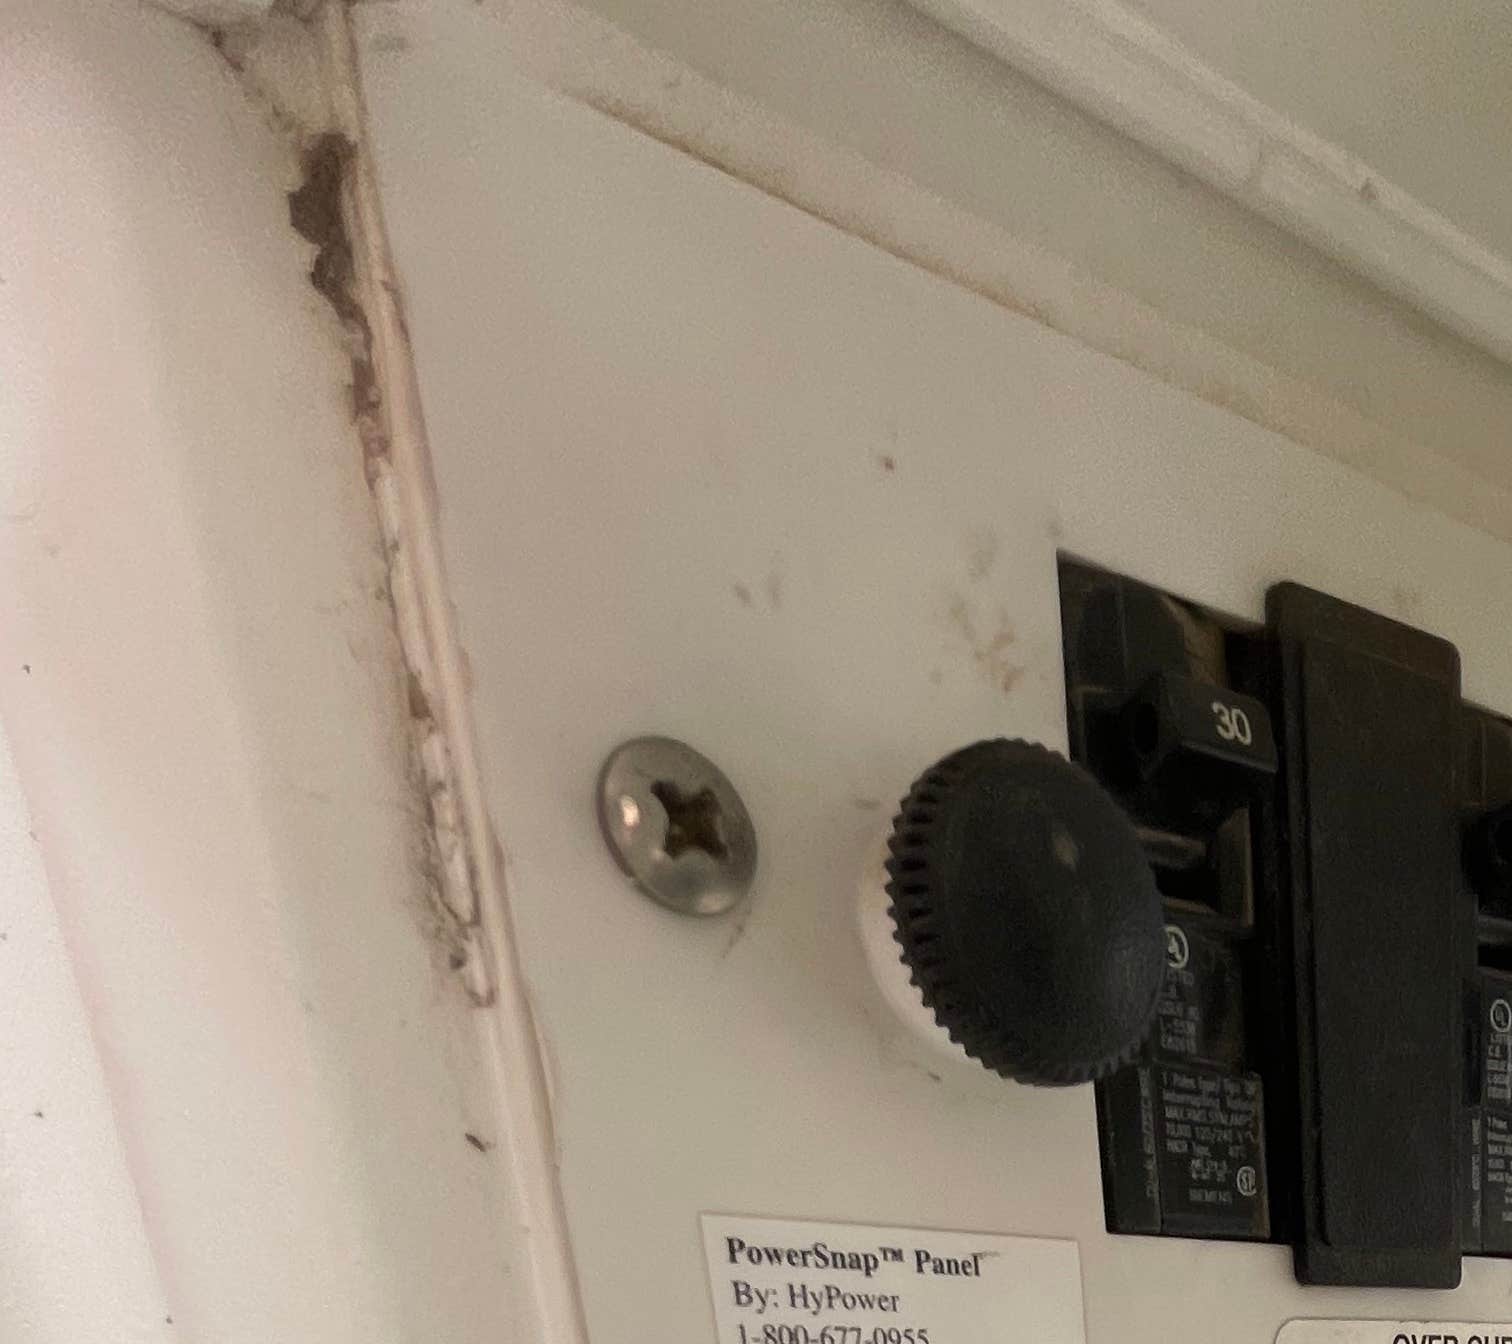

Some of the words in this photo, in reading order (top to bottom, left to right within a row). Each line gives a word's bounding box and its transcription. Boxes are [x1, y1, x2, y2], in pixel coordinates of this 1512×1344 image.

[1212, 702, 1251, 746] 30
[914, 1249, 982, 1277] Panel
[731, 1280, 780, 1314] By:
[788, 1284, 900, 1315] HyPower
